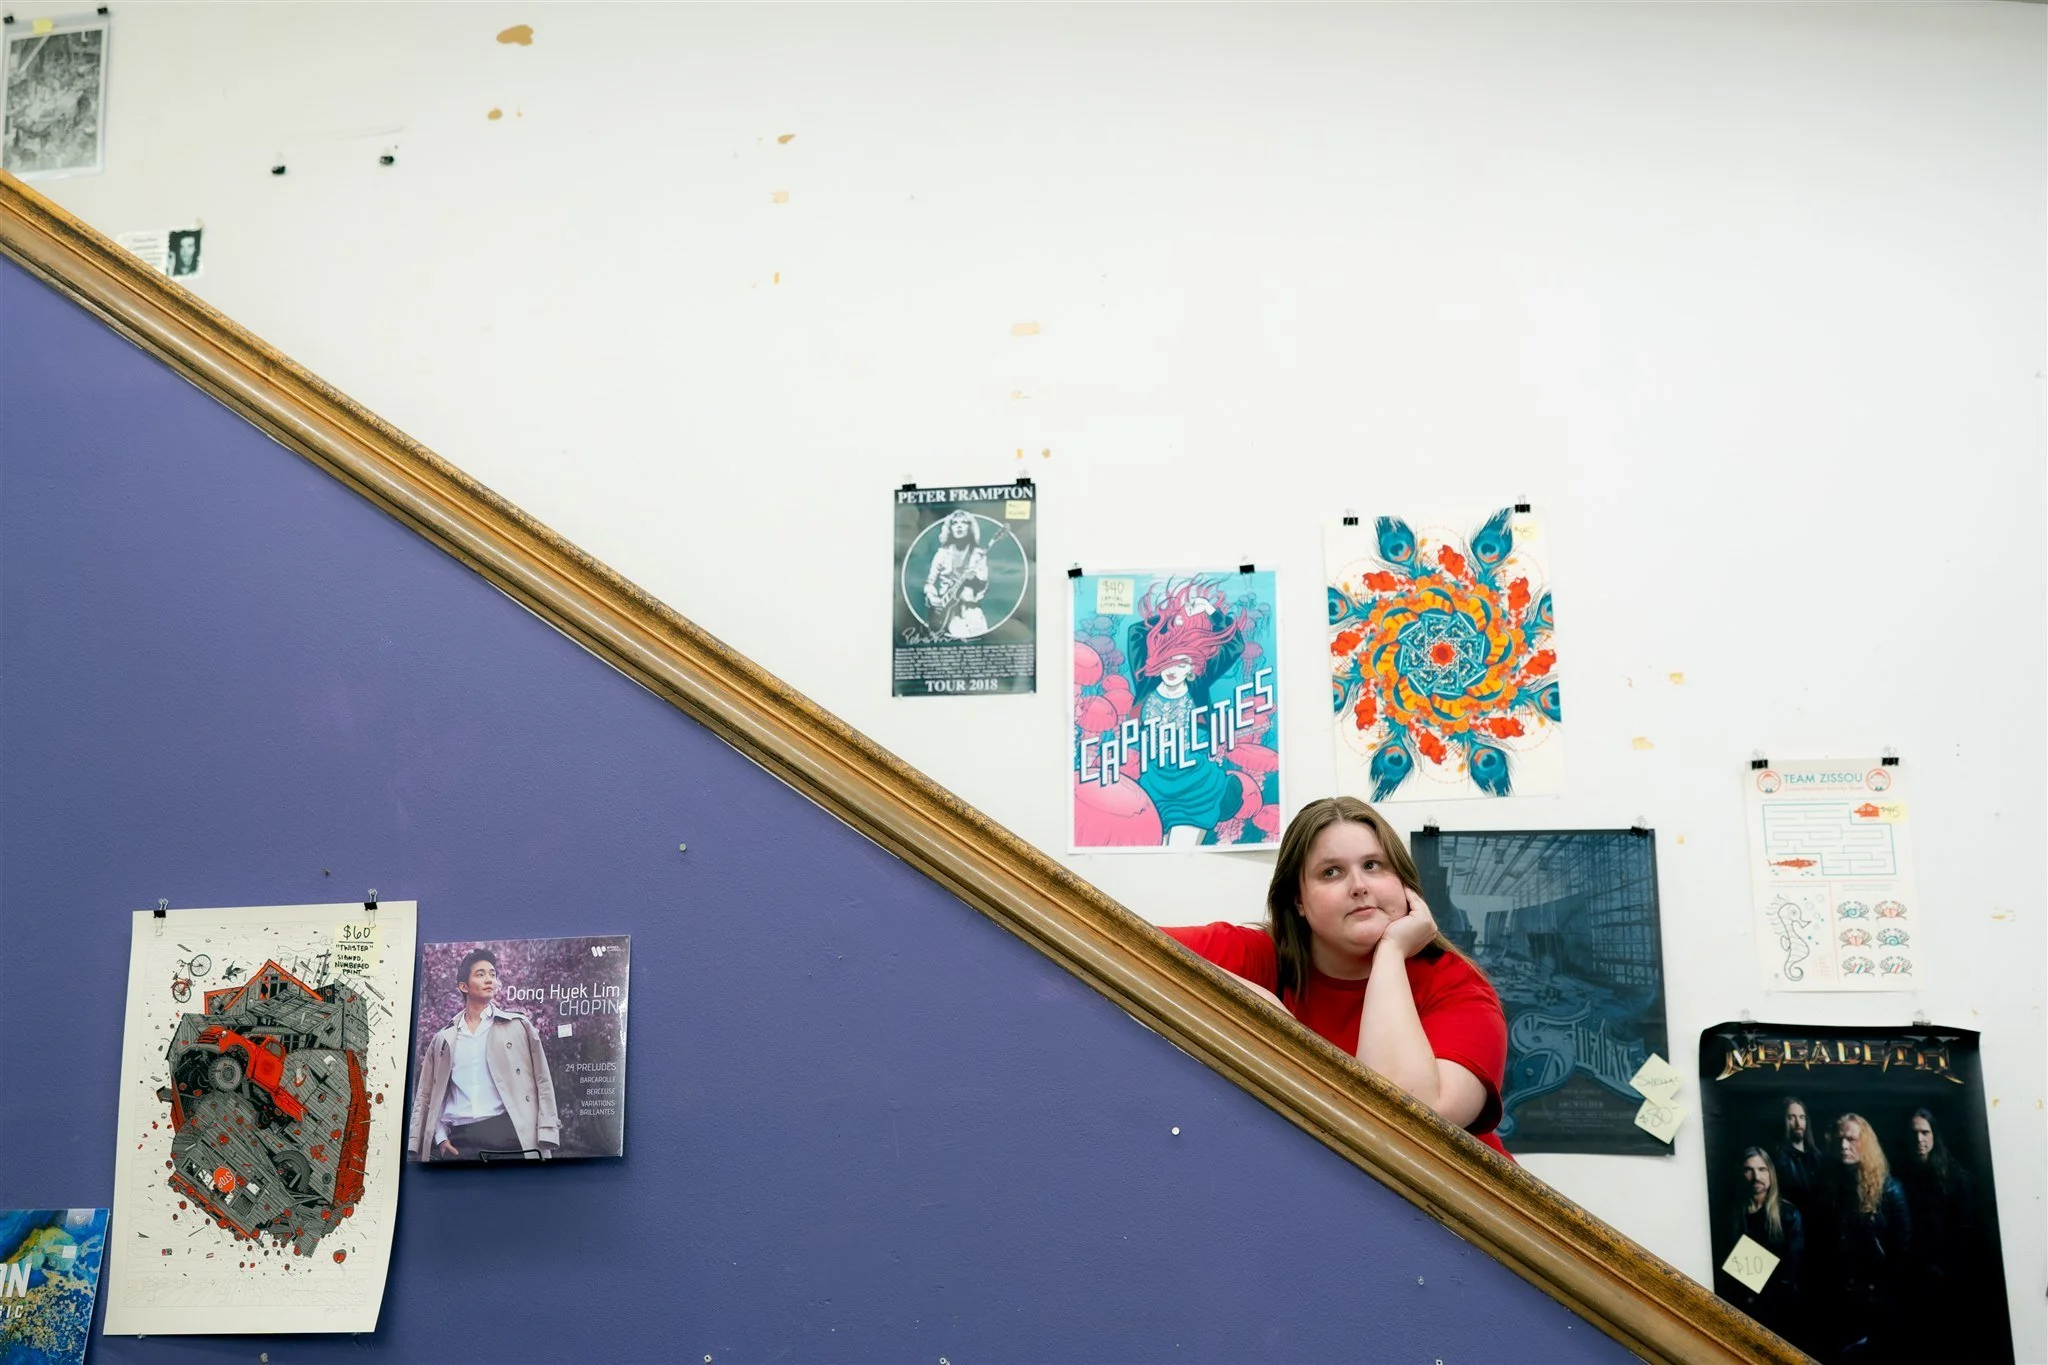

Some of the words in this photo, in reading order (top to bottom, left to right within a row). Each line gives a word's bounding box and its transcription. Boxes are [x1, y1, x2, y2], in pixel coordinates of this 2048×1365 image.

[898, 490, 946, 504] PETER
[949, 486, 1034, 501] FRAMPTON
[925, 680, 966, 692] TOUR
[968, 678, 999, 691] 2018
[1079, 718, 1196, 787] CAPITAL
[1191, 666, 1274, 757] CITIES
[1784, 773, 1816, 783] TEAM
[1819, 772, 1863, 783] ZISSOU
[343, 924, 371, 940] $60
[334, 961, 370, 969] NUMBERED
[507, 985, 544, 1004] Dong
[550, 983, 588, 1003] Hyek
[593, 982, 620, 998] Lim
[560, 999, 620, 1016] CHOPIN
[565, 1063, 575, 1072] 24
[576, 1062, 617, 1071] PRELUDES
[1714, 1033, 1965, 1085] MEGADETH
[217, 1171, 233, 1189] STOP
[1731, 1255, 1763, 1276] $10
[0, 1305, 24, 1318] IC
